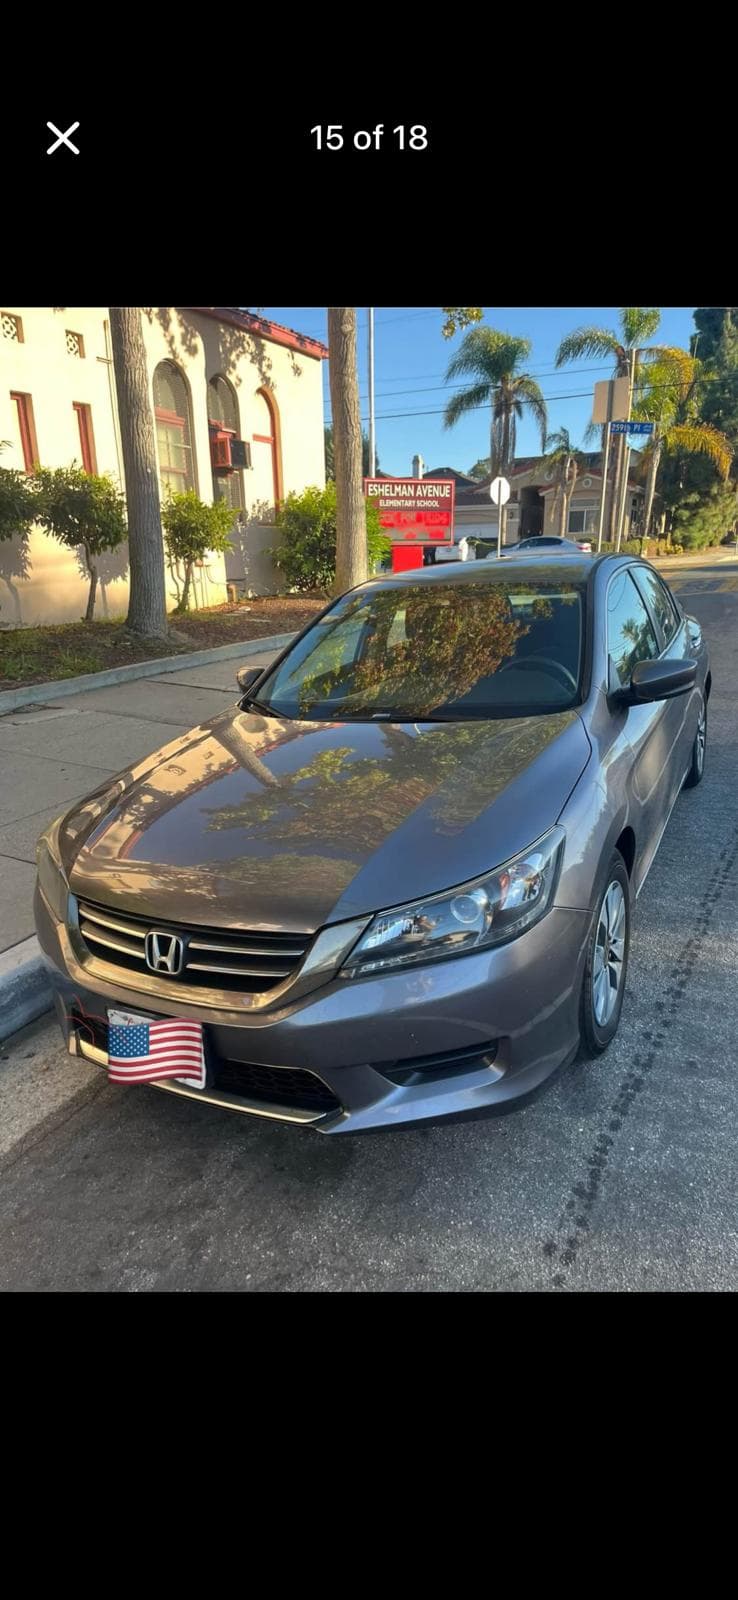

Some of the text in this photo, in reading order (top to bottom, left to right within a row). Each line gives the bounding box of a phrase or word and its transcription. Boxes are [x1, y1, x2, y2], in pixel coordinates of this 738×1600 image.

[367, 483, 451, 498] ESHELMAN AVENUE
[379, 499, 440, 508] ELEMENTARY SCHOOL
